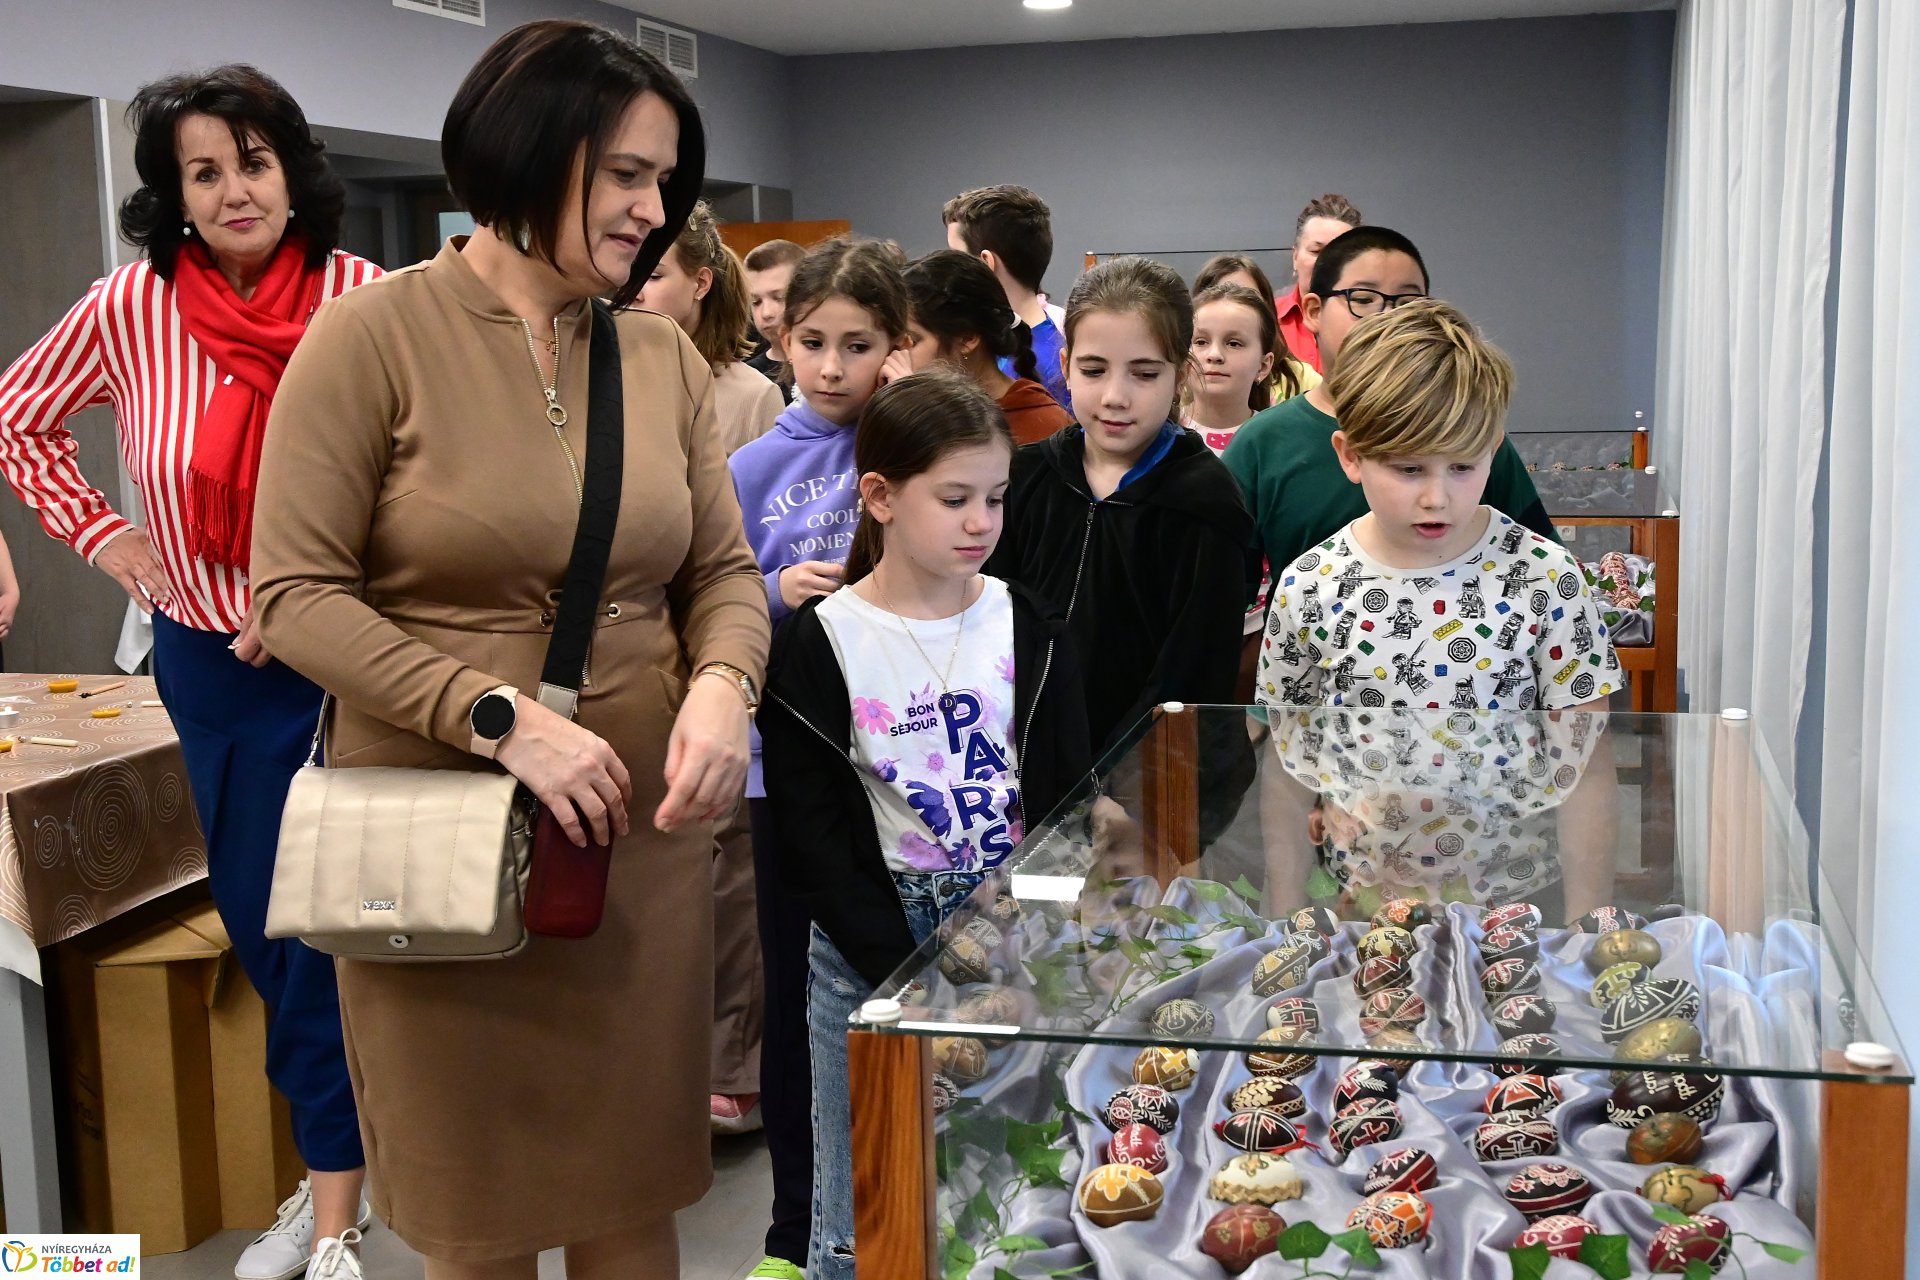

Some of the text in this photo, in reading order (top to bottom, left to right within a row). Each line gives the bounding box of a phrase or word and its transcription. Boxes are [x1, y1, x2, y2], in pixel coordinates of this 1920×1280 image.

[760, 477, 827, 533] NICE
[807, 508, 860, 529] COOL
[907, 703, 935, 718] BON
